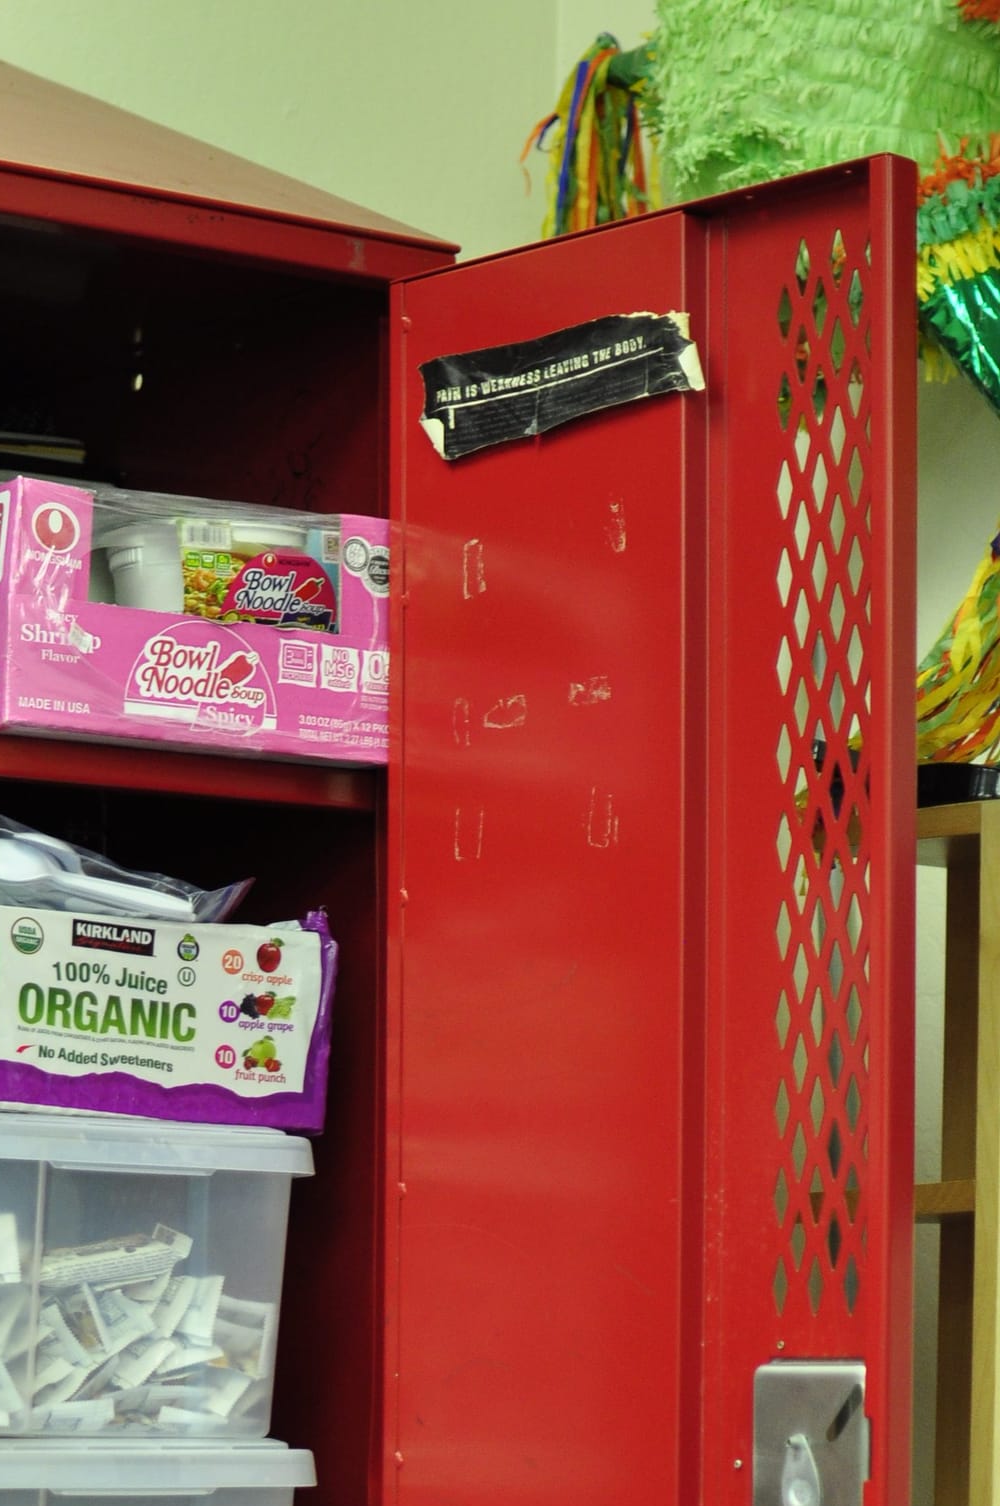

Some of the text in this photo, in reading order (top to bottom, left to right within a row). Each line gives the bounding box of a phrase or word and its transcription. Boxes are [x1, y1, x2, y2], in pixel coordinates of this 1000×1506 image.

[436, 336, 647, 403] PAIN IS WEAKNESS LEAVING THE BODY.
[245, 571, 296, 593] Bowl
[236, 590, 301, 612] Noodle
[20, 623, 101, 654] Shrip
[41, 649, 80, 664] Flavor
[151, 639, 218, 672] Bowl
[324, 660, 355, 679] MSG
[141, 667, 230, 698] Noodle
[18, 696, 91, 714] MADE IN USA
[205, 705, 256, 727] Spicy
[75, 922, 152, 945] KIRKLAND
[224, 954, 242, 970] 20
[52, 961, 168, 995] 100% Juice
[242, 972, 293, 985] crisp apple
[18, 982, 197, 1042] ORGANIC
[221, 1005, 237, 1019] 10
[238, 1020, 294, 1032] apple grape
[38, 1045, 173, 1073] No Added Sweeteners
[218, 1049, 233, 1064] 10
[235, 1069, 286, 1083] fruit punch
